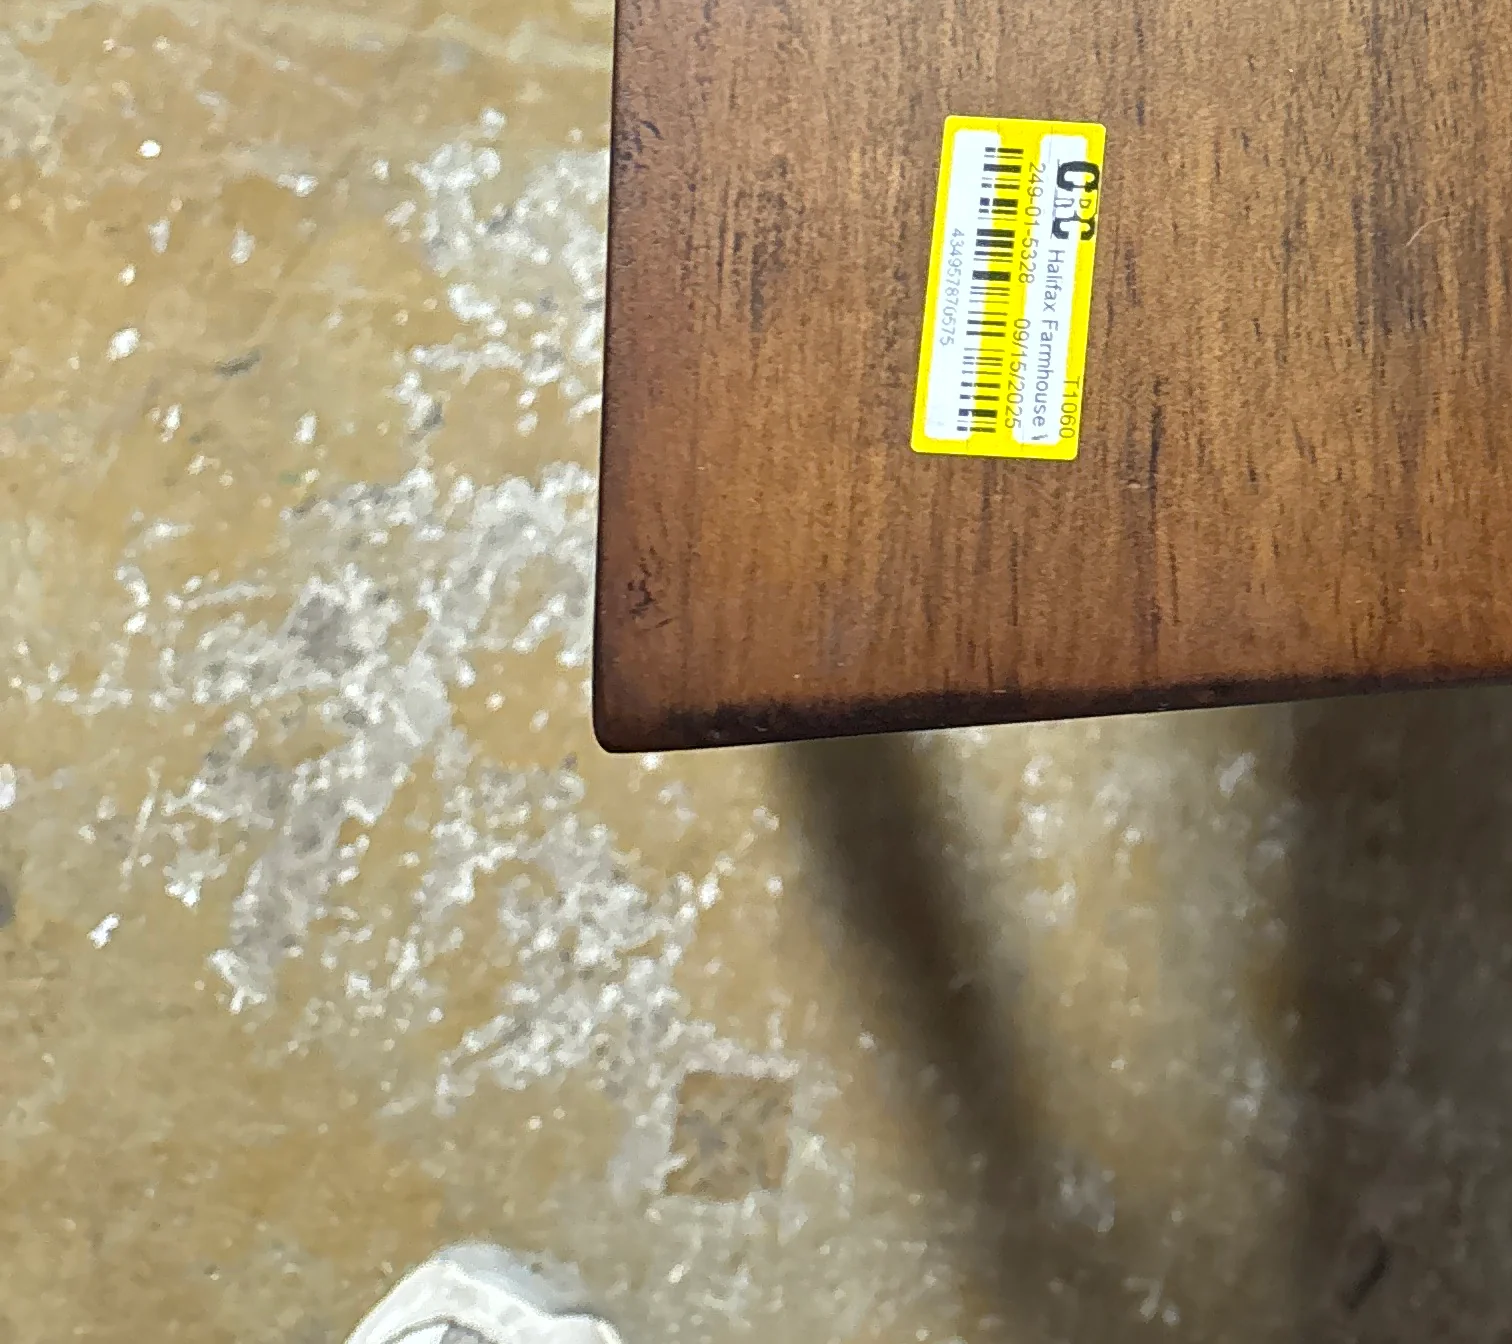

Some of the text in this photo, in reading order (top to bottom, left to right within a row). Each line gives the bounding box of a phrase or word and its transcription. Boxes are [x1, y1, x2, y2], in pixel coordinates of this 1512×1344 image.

[939, 228, 965, 347] 434957870575
[1004, 161, 1046, 430] 249-01-5328 09/15/2025
[1042, 249, 1066, 312] Halifax
[1032, 319, 1059, 427] Farmhouse
[1059, 376, 1080, 439] T1060
